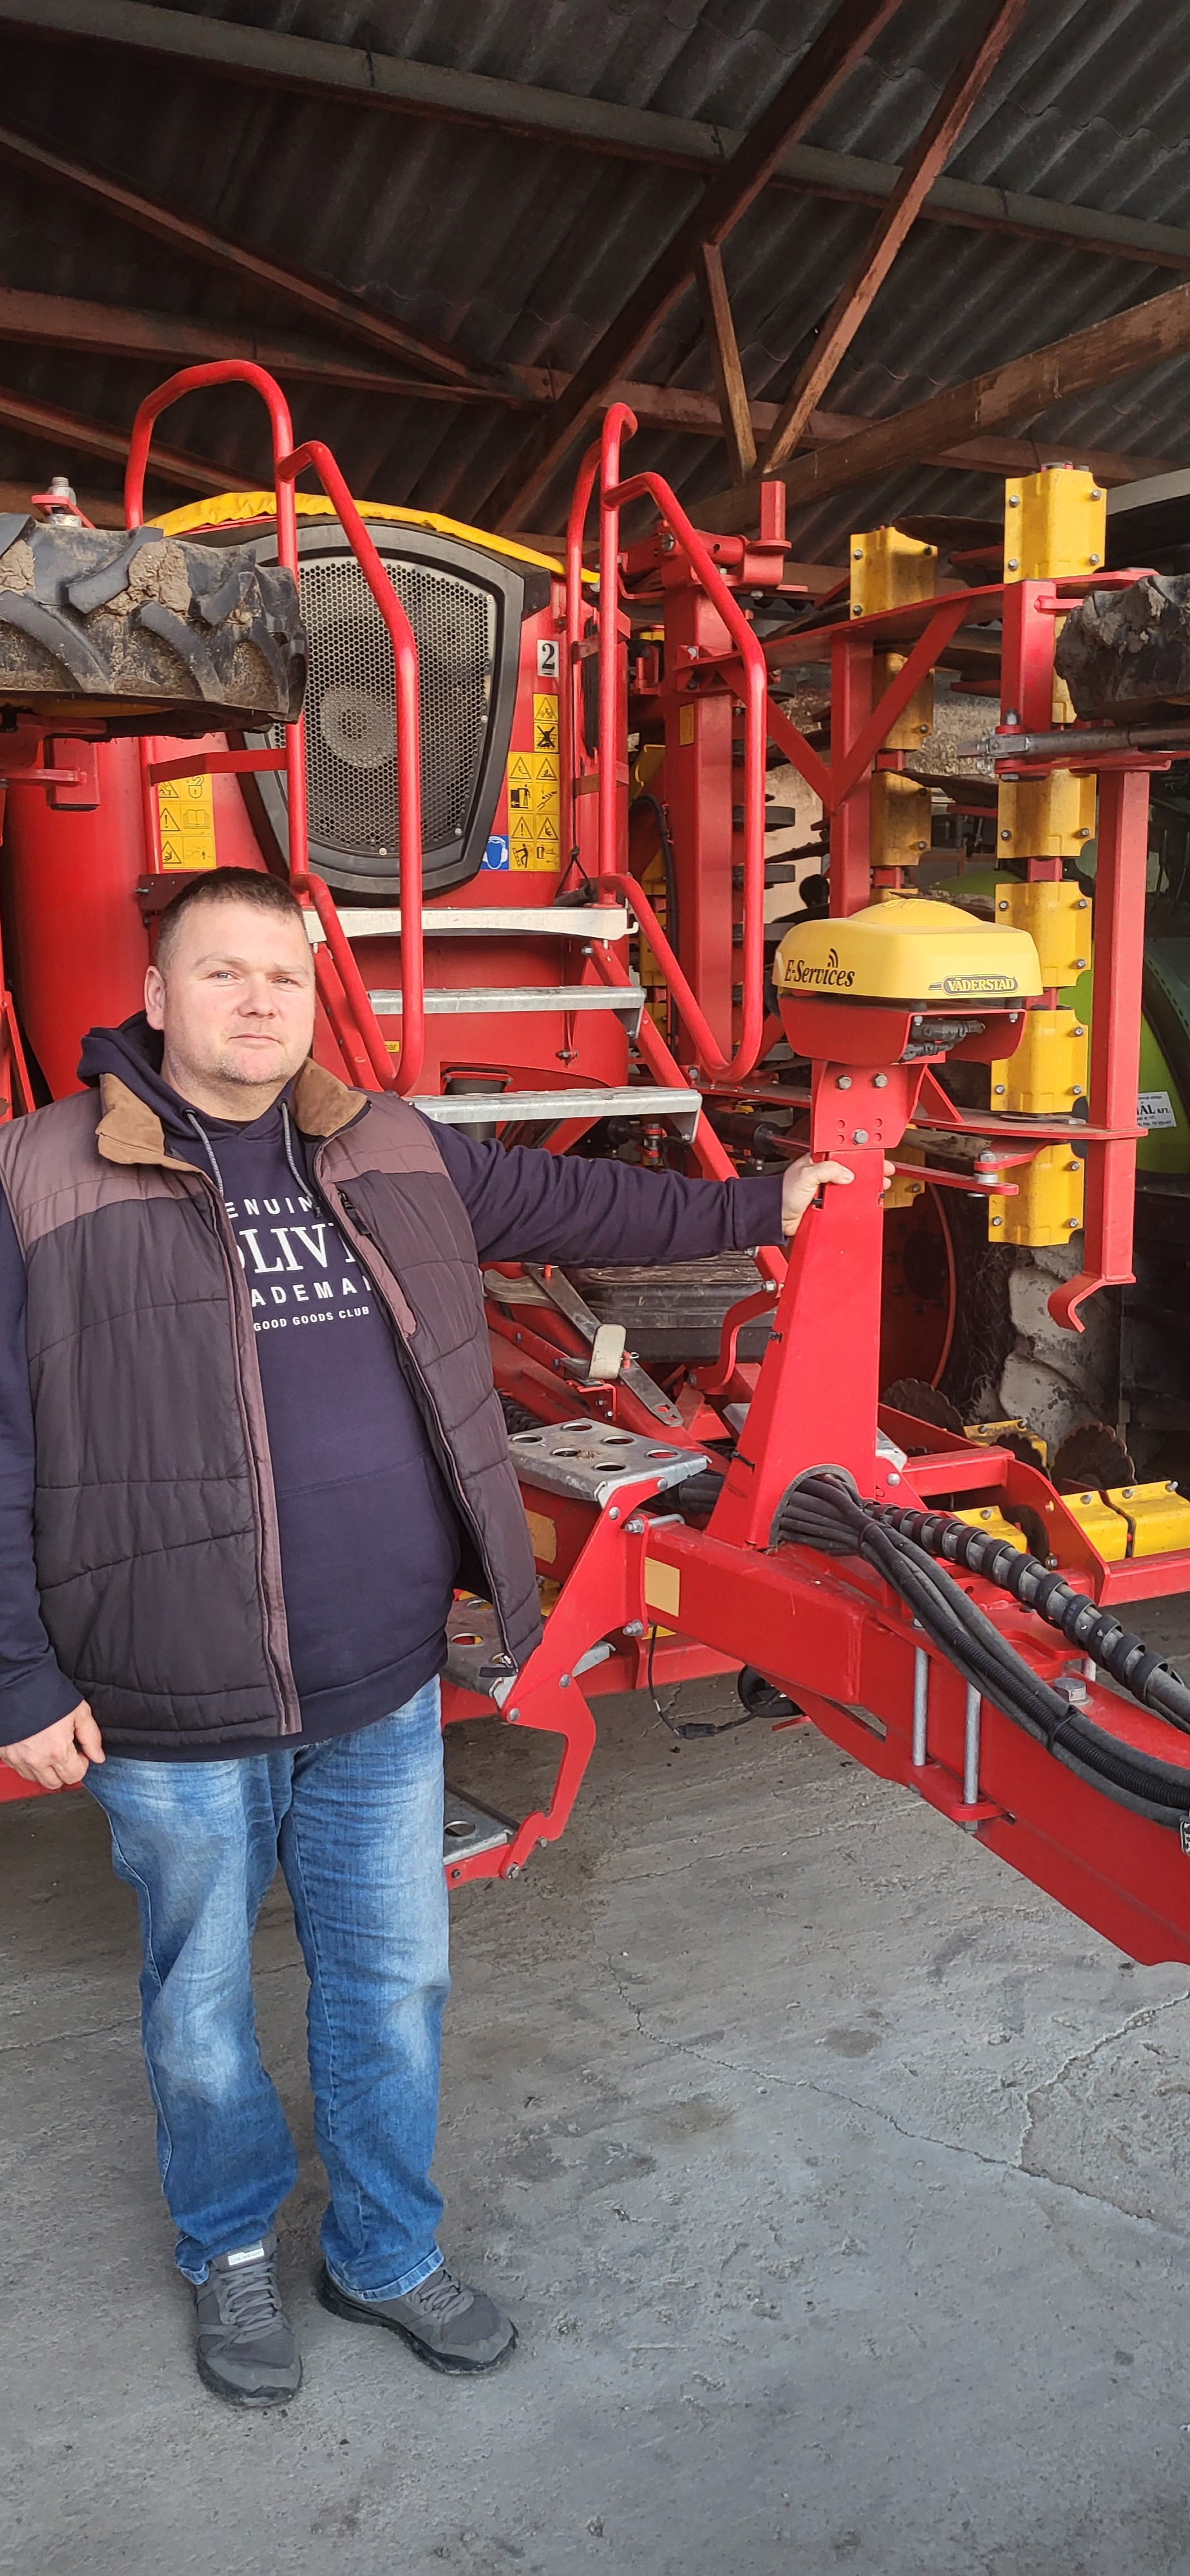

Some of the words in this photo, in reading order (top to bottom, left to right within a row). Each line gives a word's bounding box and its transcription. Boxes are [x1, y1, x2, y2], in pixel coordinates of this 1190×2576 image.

[542, 643, 555, 670] 2
[784, 959, 855, 987] E-Services
[947, 977, 1015, 992] VÄDERSTAD
[236, 1222, 356, 1274] LIV
[253, 1318, 287, 1332] GOOD
[292, 1312, 334, 1326] GOODS
[338, 1306, 370, 1319] CLUB
